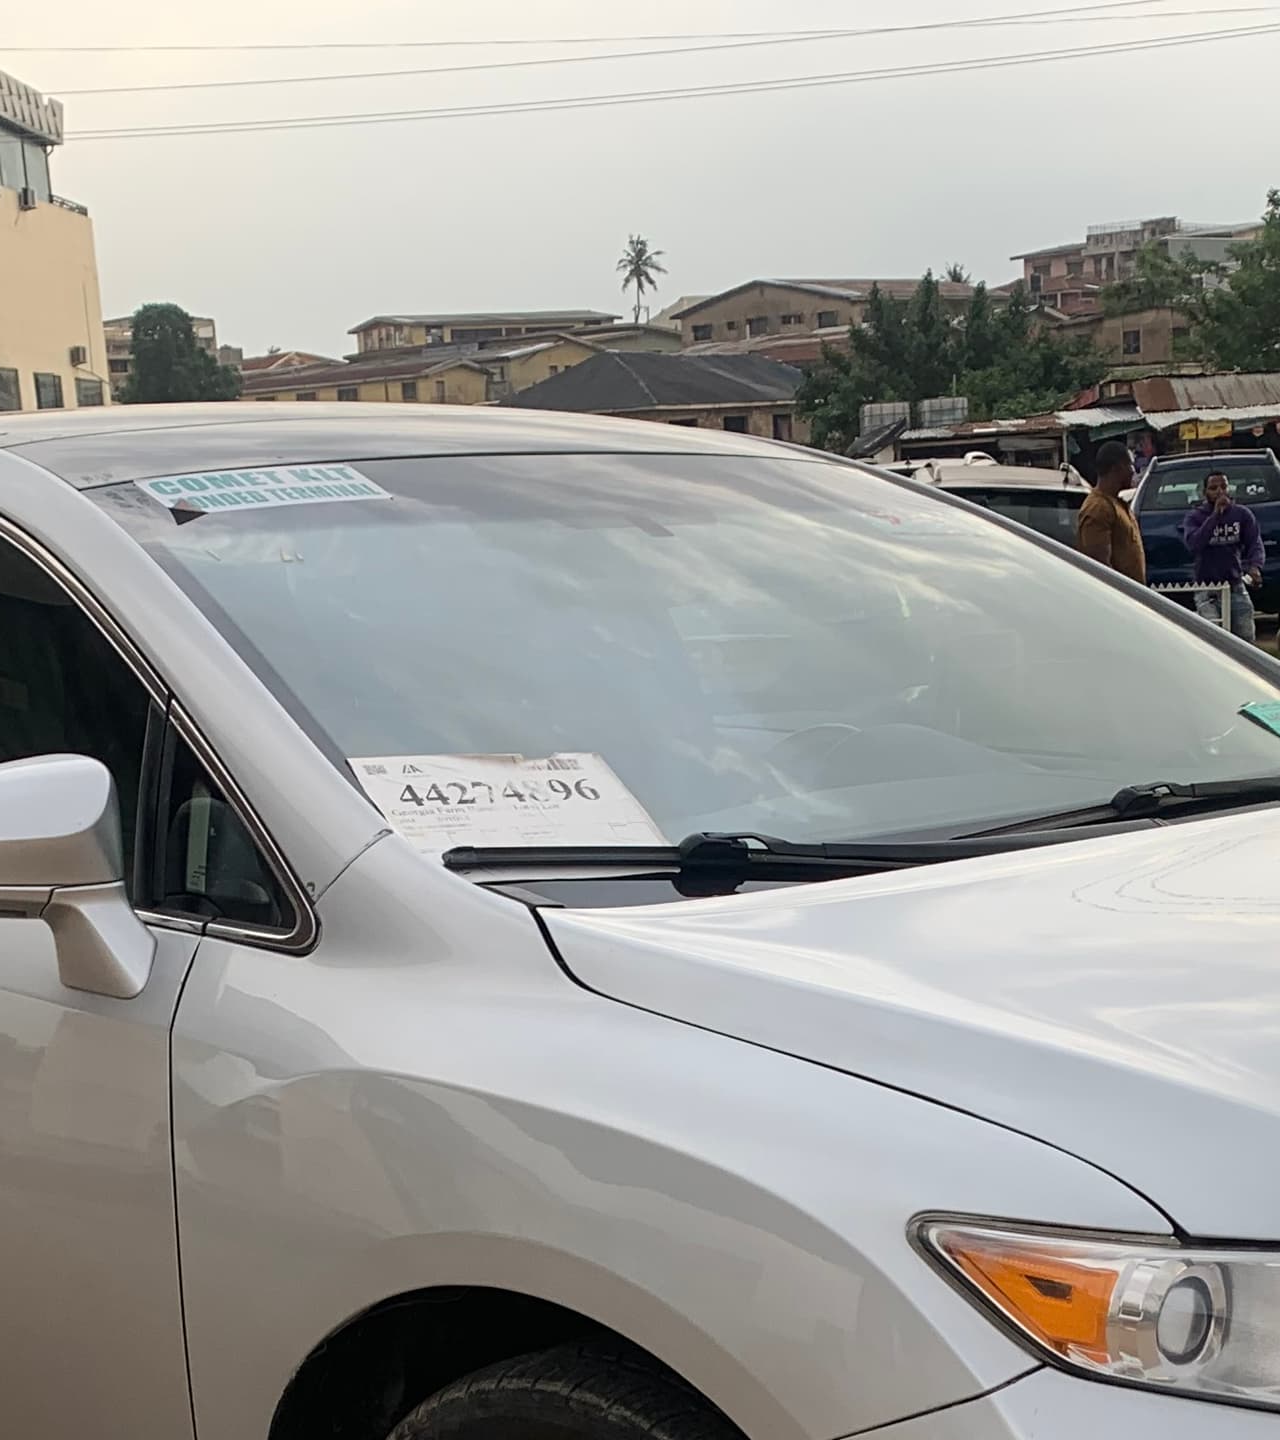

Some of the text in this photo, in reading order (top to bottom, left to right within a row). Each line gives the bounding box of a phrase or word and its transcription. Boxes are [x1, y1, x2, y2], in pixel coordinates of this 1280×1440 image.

[148, 470, 285, 495] COMET
[168, 482, 382, 510] ONDED TERMINAL
[400, 777, 601, 807] 44274896
